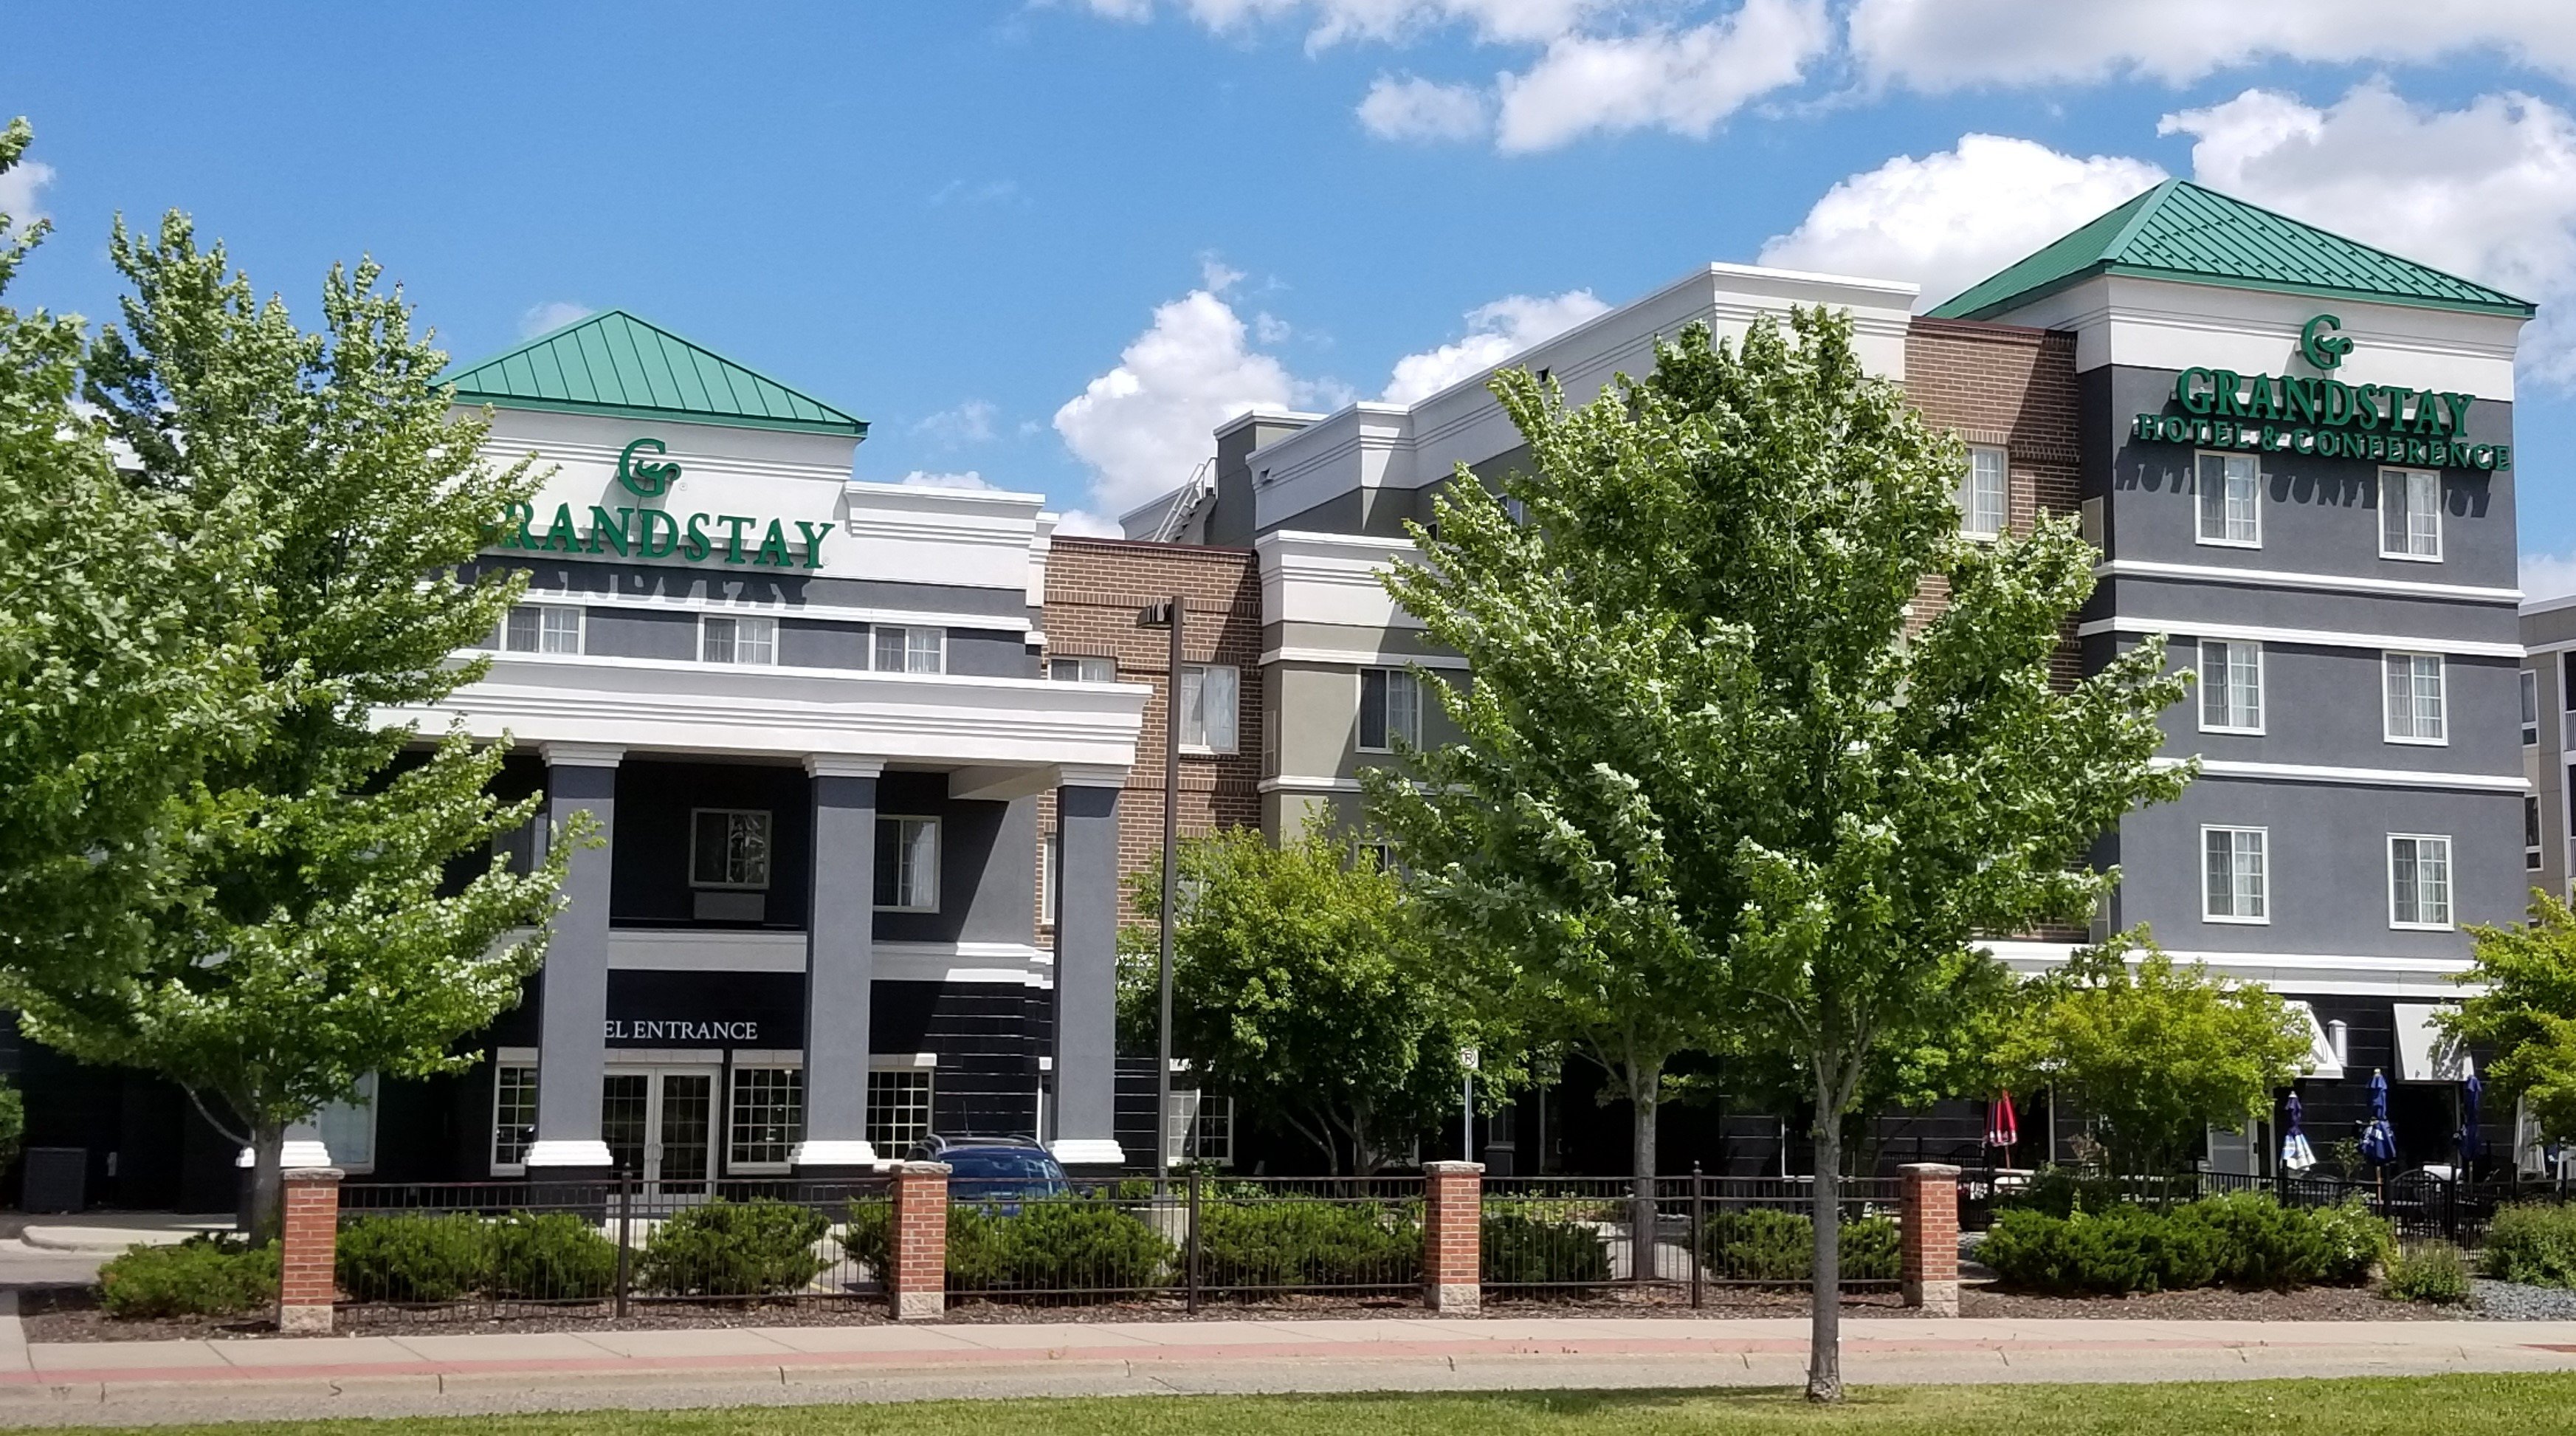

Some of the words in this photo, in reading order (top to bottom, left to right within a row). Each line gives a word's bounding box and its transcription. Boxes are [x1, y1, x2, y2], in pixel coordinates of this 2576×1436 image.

[2175, 366, 2475, 437] GRANDSTAY
[2139, 413, 2250, 450] HOTEL
[2262, 425, 2283, 452] &
[2295, 428, 2511, 471] CONFERENCE
[481, 500, 836, 569] RANDSTAY
[633, 1020, 757, 1040] ENTRANCE
